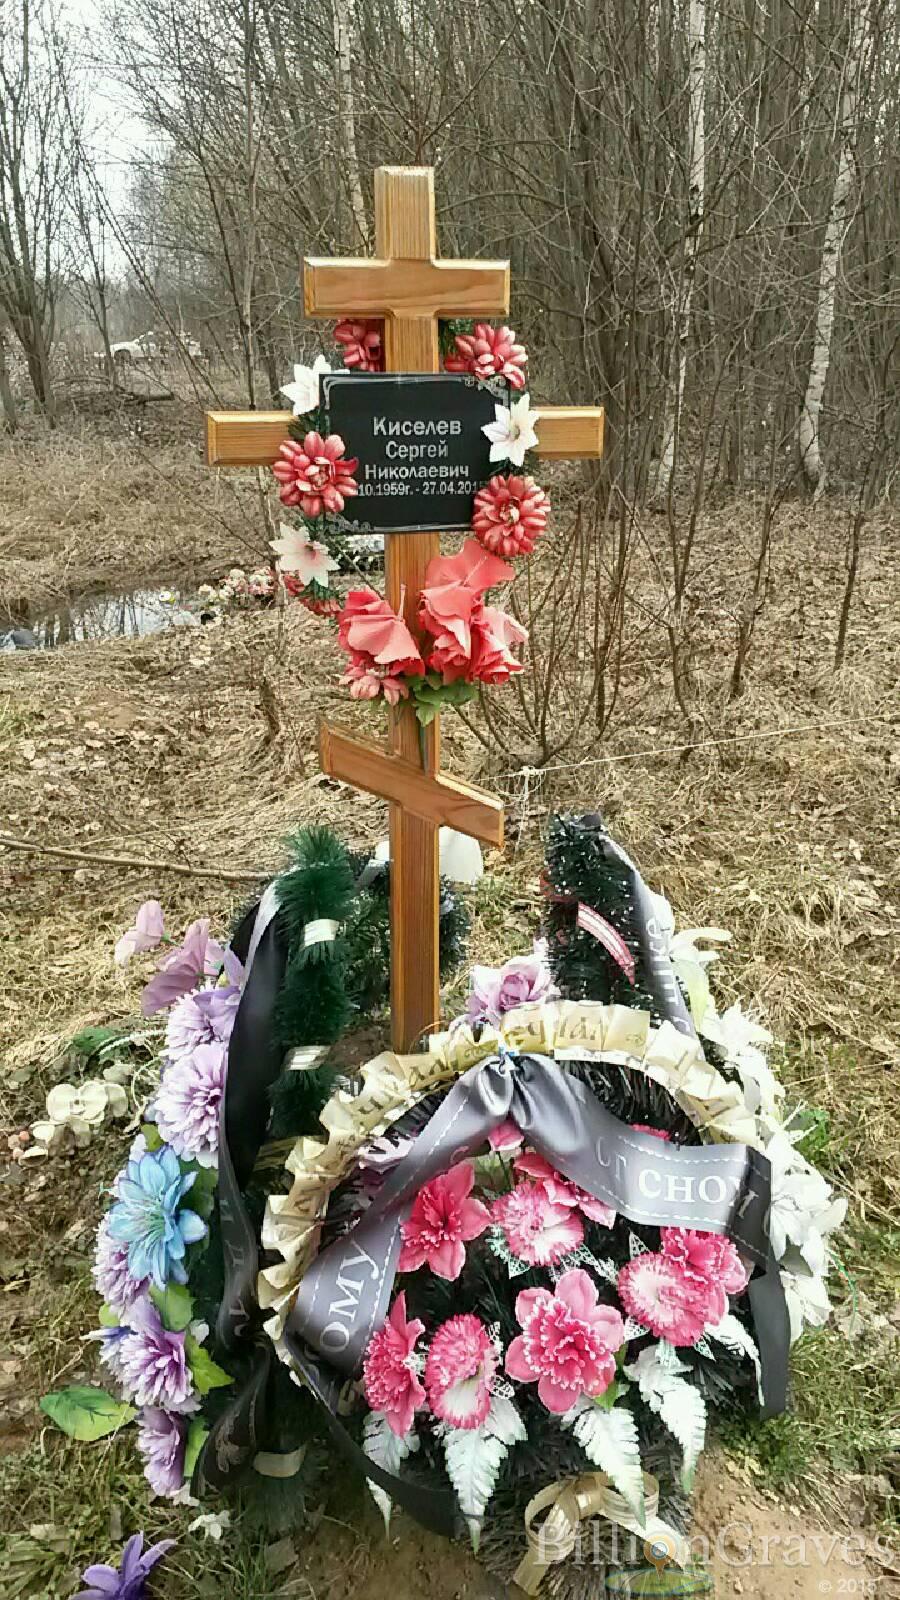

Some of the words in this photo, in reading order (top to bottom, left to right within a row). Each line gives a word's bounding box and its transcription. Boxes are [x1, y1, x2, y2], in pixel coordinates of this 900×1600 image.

[373, 416, 462, 436] Киселев
[385, 439, 449, 462] Сергей
[364, 464, 470, 480] Николаевич
[358, 483, 414, 497] 10.1959г.
